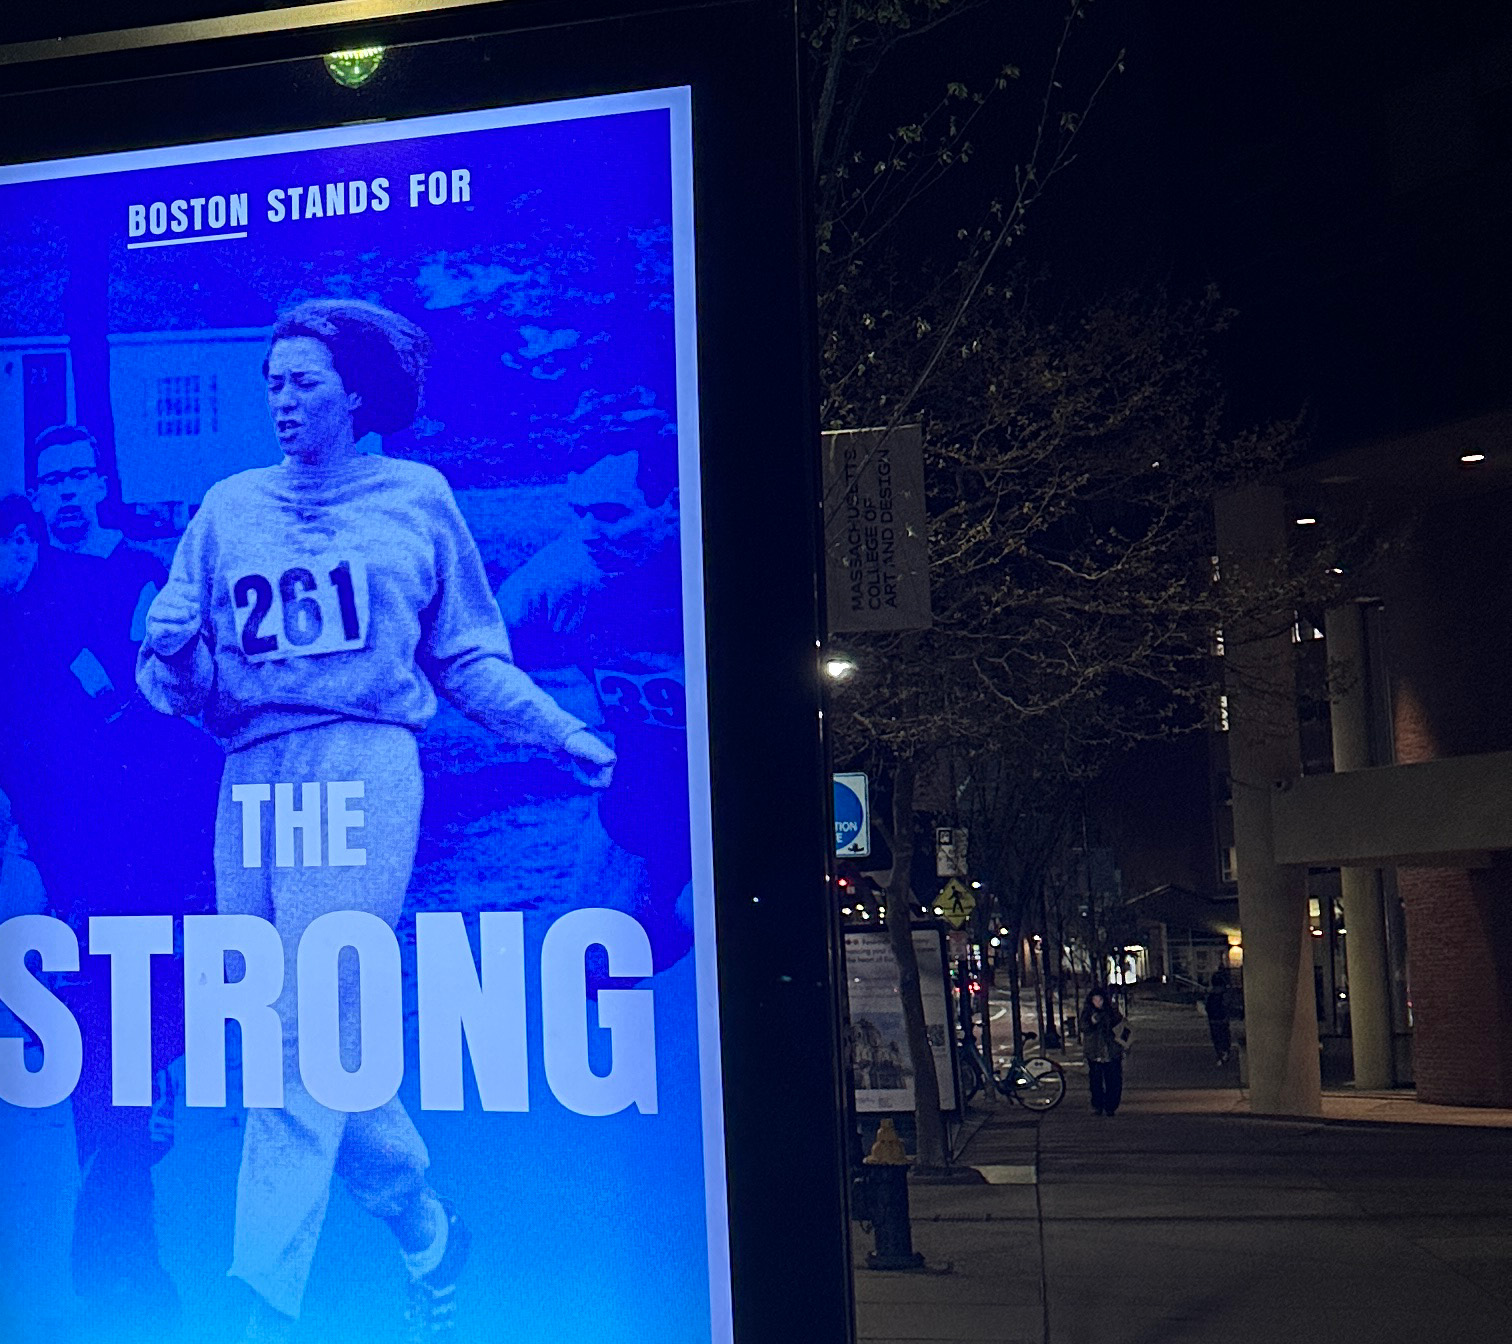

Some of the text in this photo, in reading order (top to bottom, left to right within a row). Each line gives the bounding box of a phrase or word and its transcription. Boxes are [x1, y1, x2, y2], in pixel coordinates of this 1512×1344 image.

[129, 168, 471, 237] BOSTON STANDS FOR
[863, 498, 881, 610] COLLEGE OF
[878, 449, 897, 608] ART AND DESIGN
[233, 560, 361, 656] 261
[232, 780, 367, 868] THE
